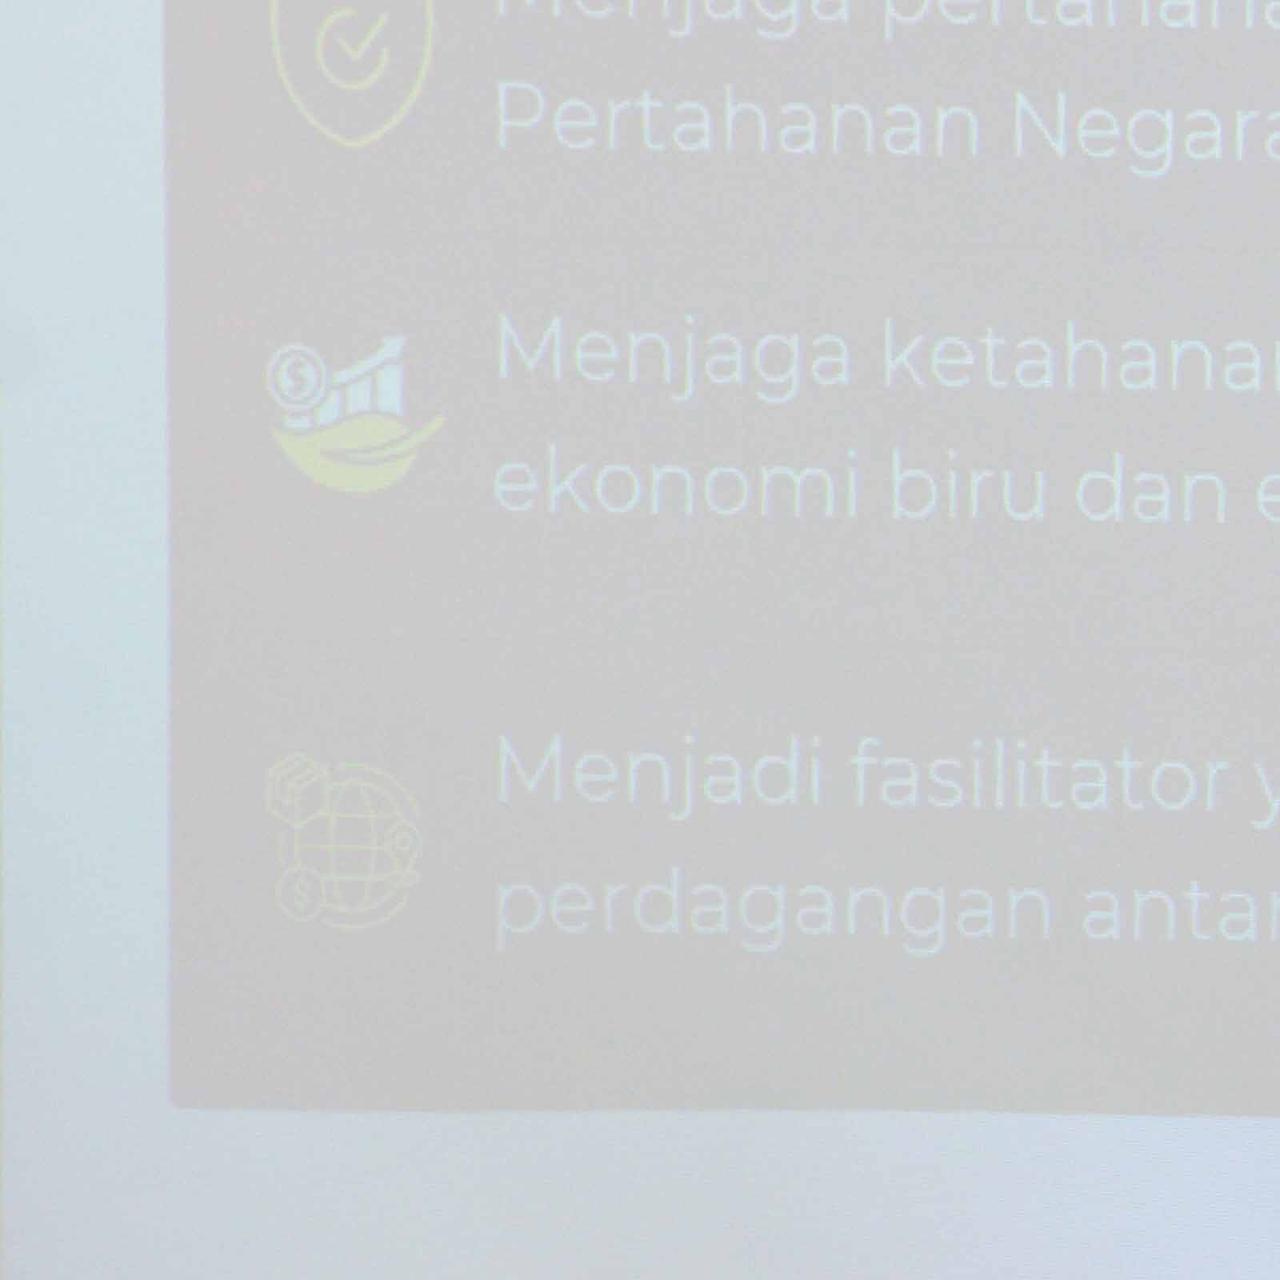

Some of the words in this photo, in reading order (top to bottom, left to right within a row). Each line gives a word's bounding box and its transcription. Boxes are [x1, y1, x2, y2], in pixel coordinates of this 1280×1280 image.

[496, 80, 982, 159] Pertahanan
[497, 312, 853, 404] Menjaga
[492, 443, 863, 519] ekonomi
[890, 447, 1048, 522] biru
[1075, 453, 1229, 527] dan
[496, 731, 824, 821] Menjadi
[850, 736, 1231, 813] fasilitator
[496, 866, 1056, 958] perdagangan
